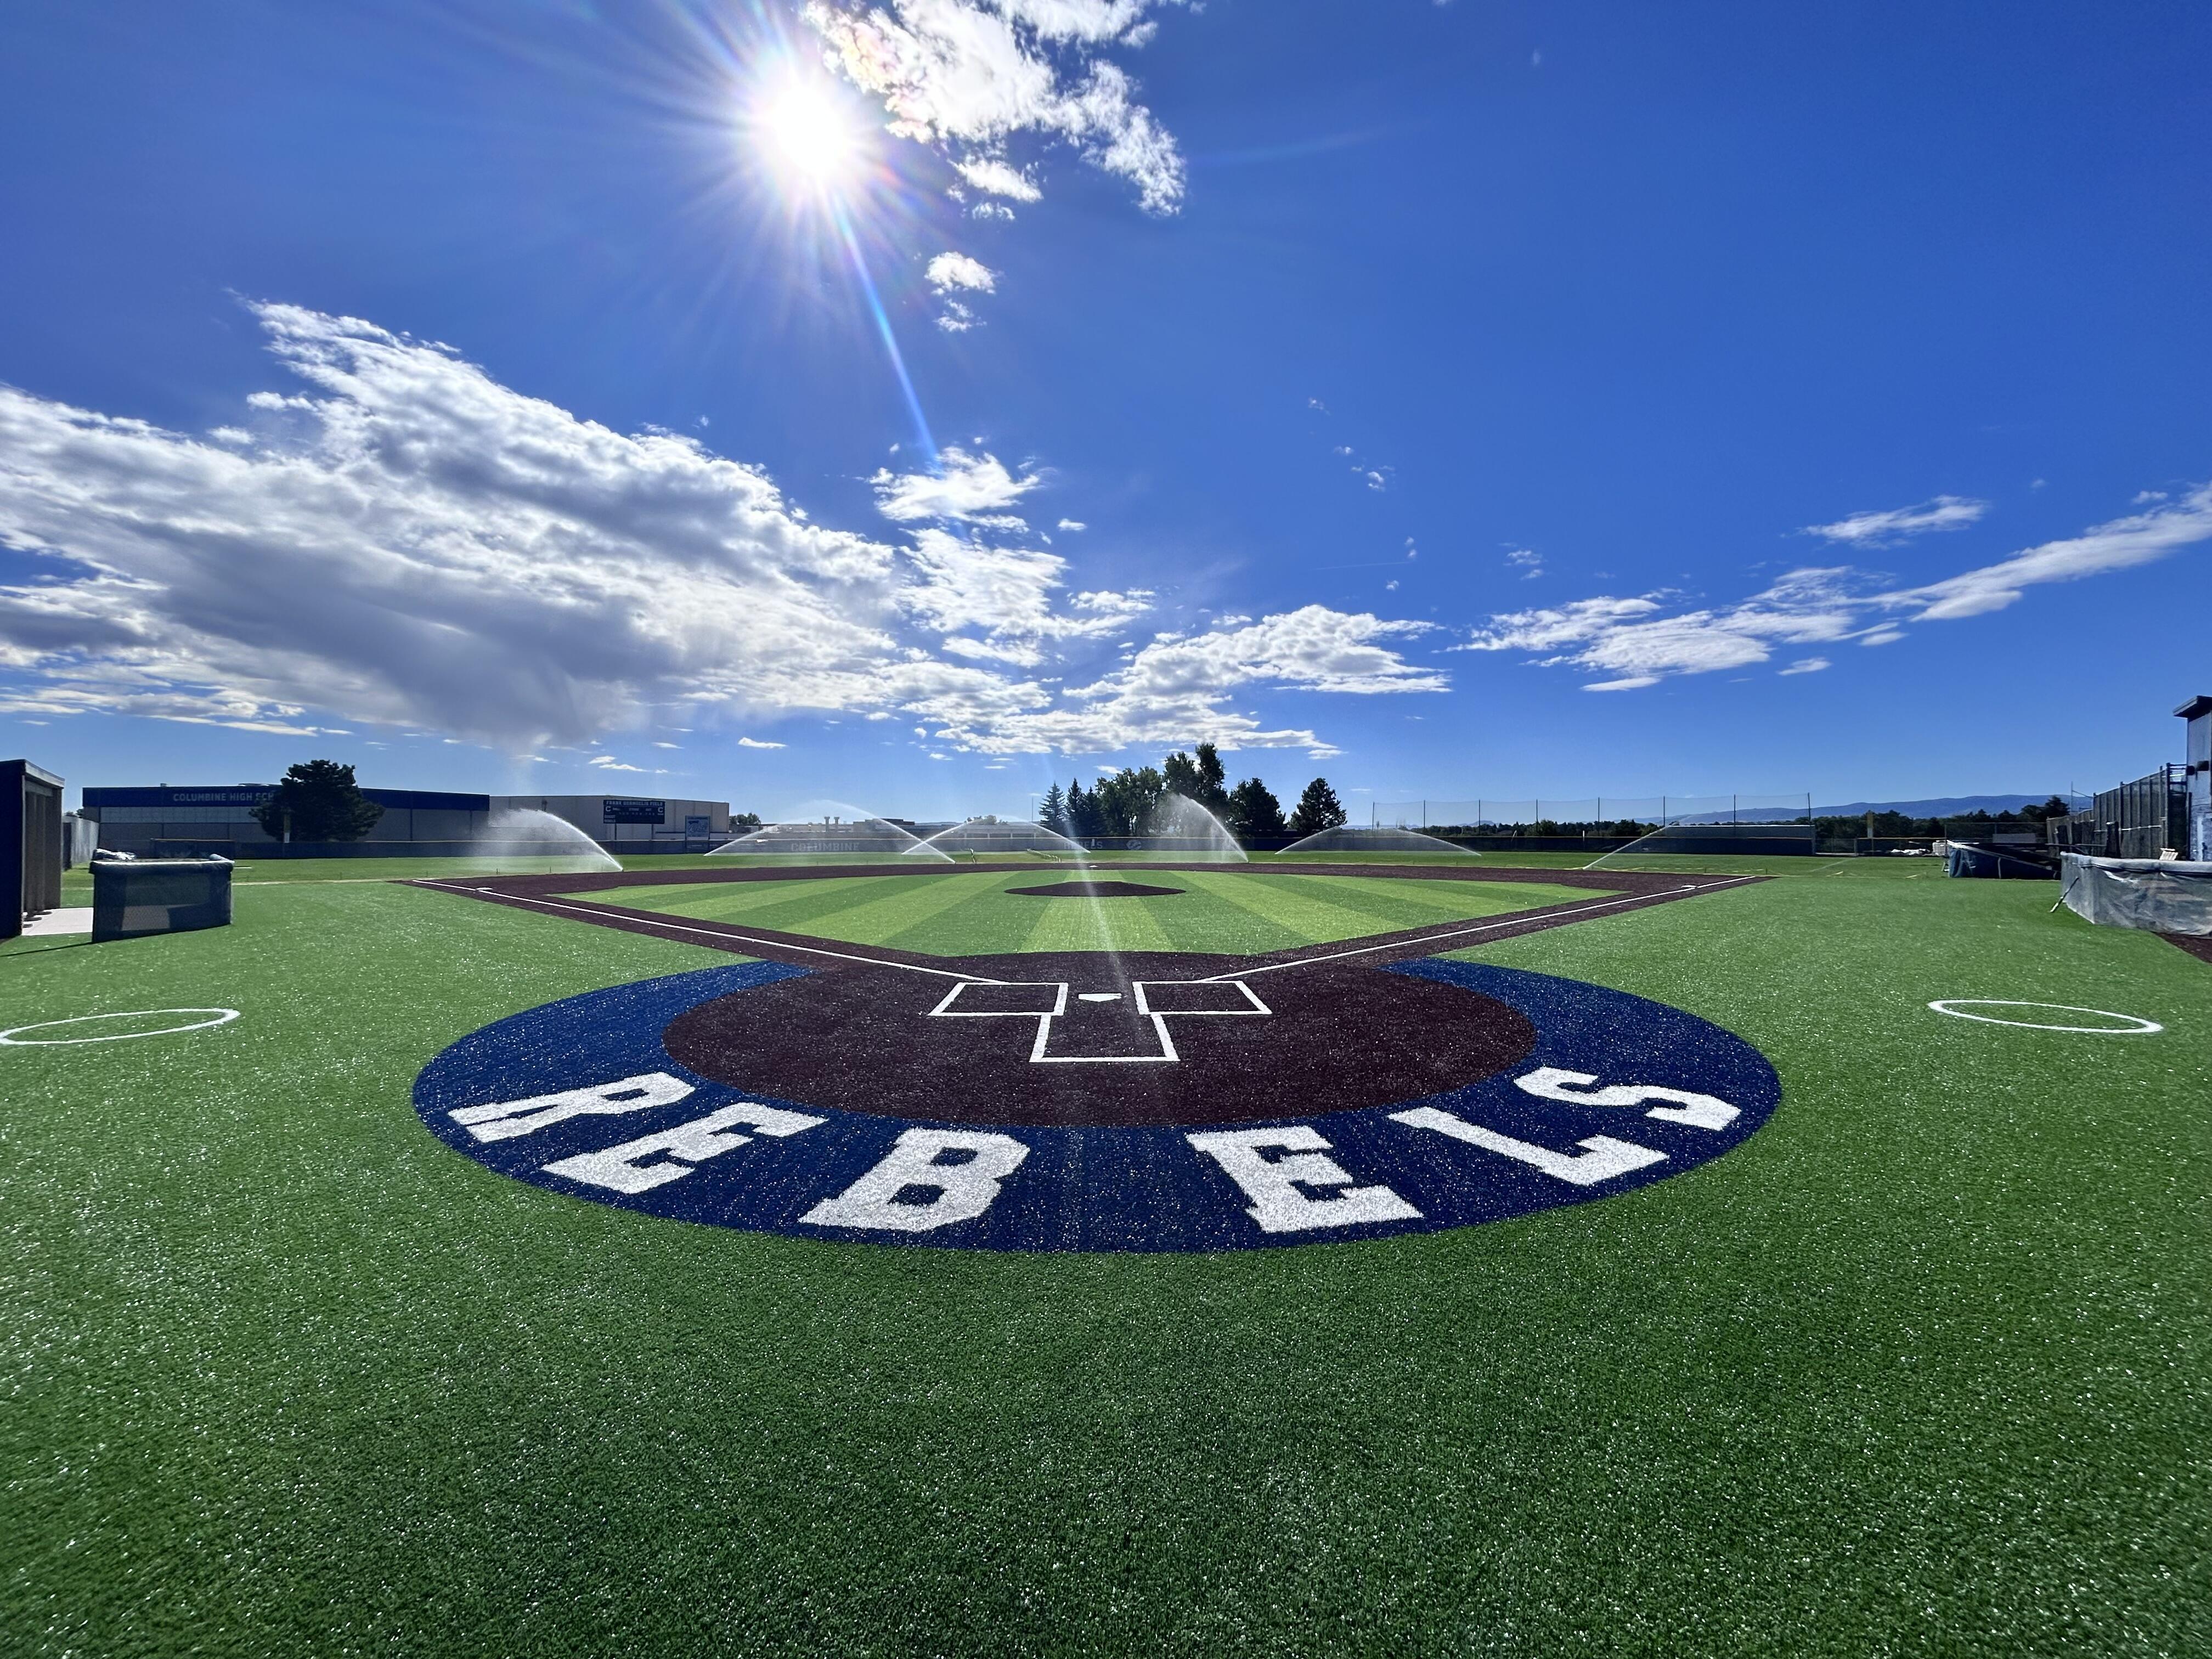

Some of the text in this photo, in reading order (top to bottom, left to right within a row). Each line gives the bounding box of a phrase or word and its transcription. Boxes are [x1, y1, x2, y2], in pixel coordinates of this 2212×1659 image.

[173, 792, 274, 802] COLUMBINE HIGH SCH
[791, 842, 860, 851] COLUMBINE
[448, 1066, 1742, 1232] REBELS
